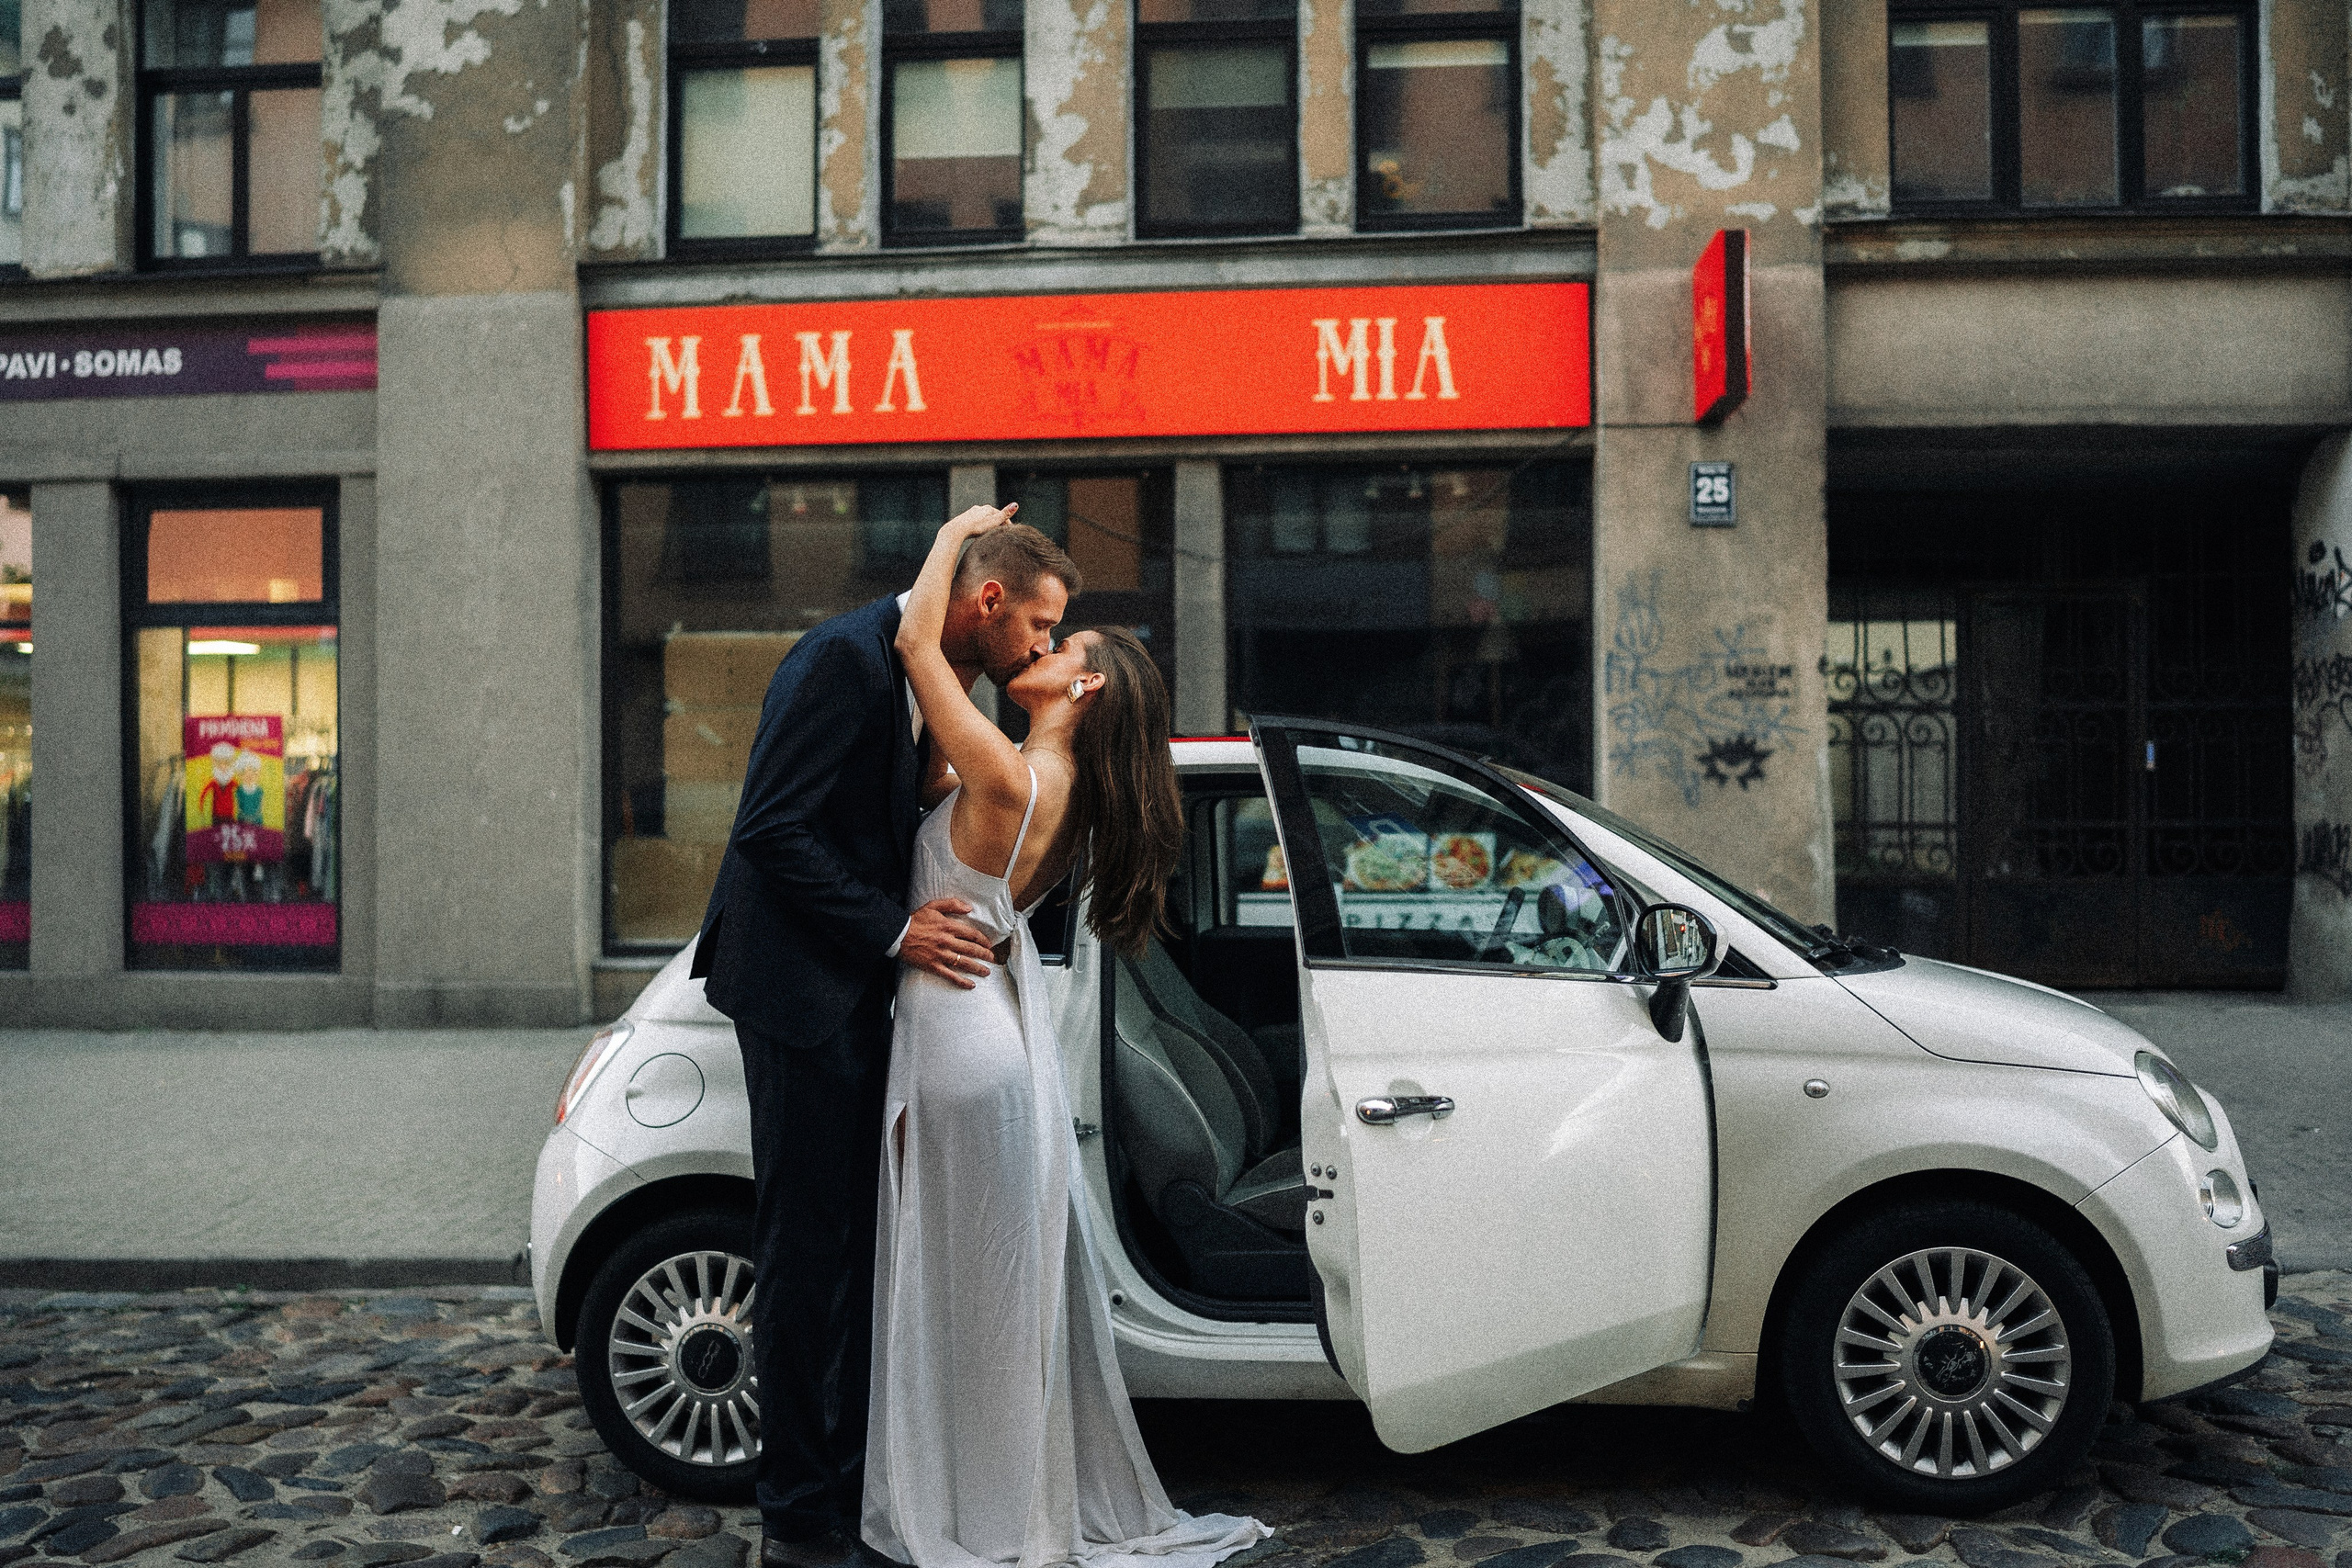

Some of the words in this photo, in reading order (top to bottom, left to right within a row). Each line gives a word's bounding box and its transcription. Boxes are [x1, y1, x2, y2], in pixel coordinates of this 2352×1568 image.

[74, 347, 183, 378] SOMAS
[645, 329, 927, 420] MAMA
[1311, 316, 1460, 402] MIA
[1696, 476, 1729, 503] 25
